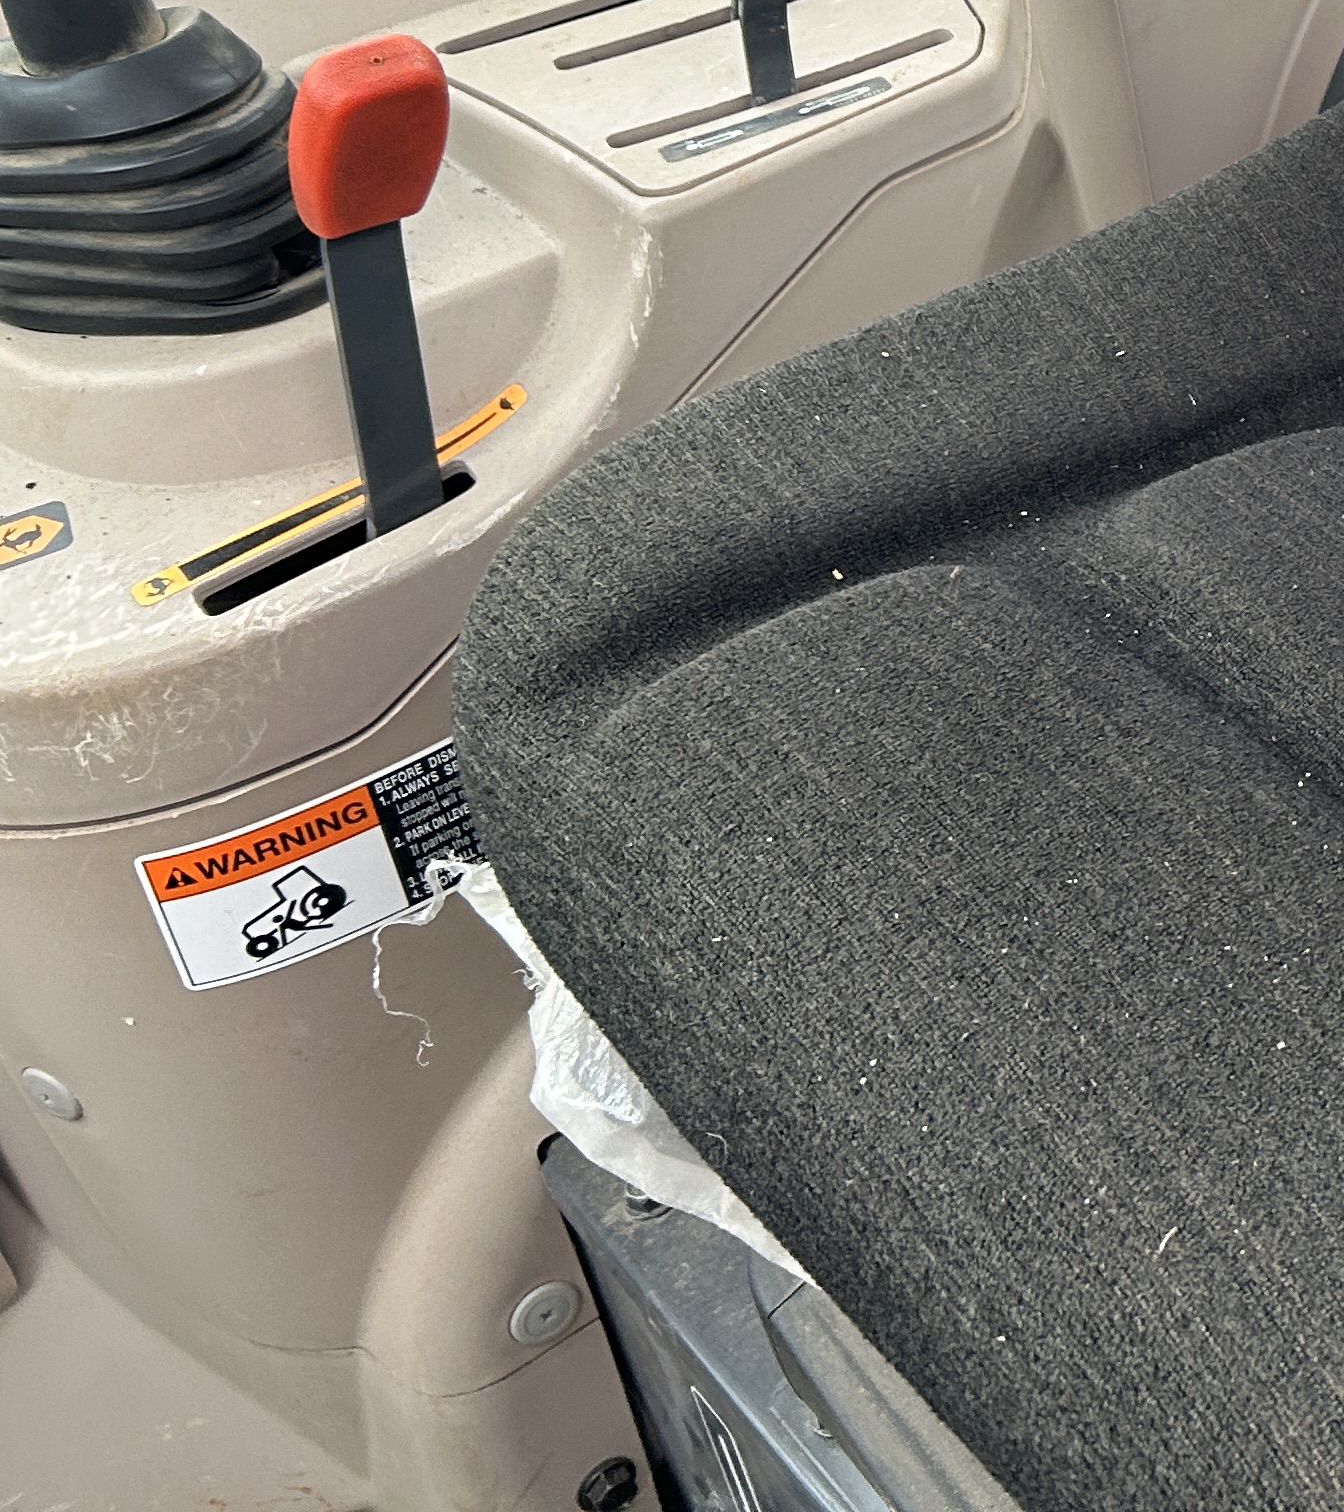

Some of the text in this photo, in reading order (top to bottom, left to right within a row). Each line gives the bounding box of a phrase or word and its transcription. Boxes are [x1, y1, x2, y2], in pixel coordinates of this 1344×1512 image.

[373, 762, 425, 794] BEFORE
[396, 790, 437, 815] Leaving
[401, 800, 441, 828] stopped
[195, 800, 370, 880] WARNING
[404, 822, 433, 843] PARK
[431, 814, 448, 829] ON
[421, 825, 462, 853] parking
[452, 834, 471, 852] the
